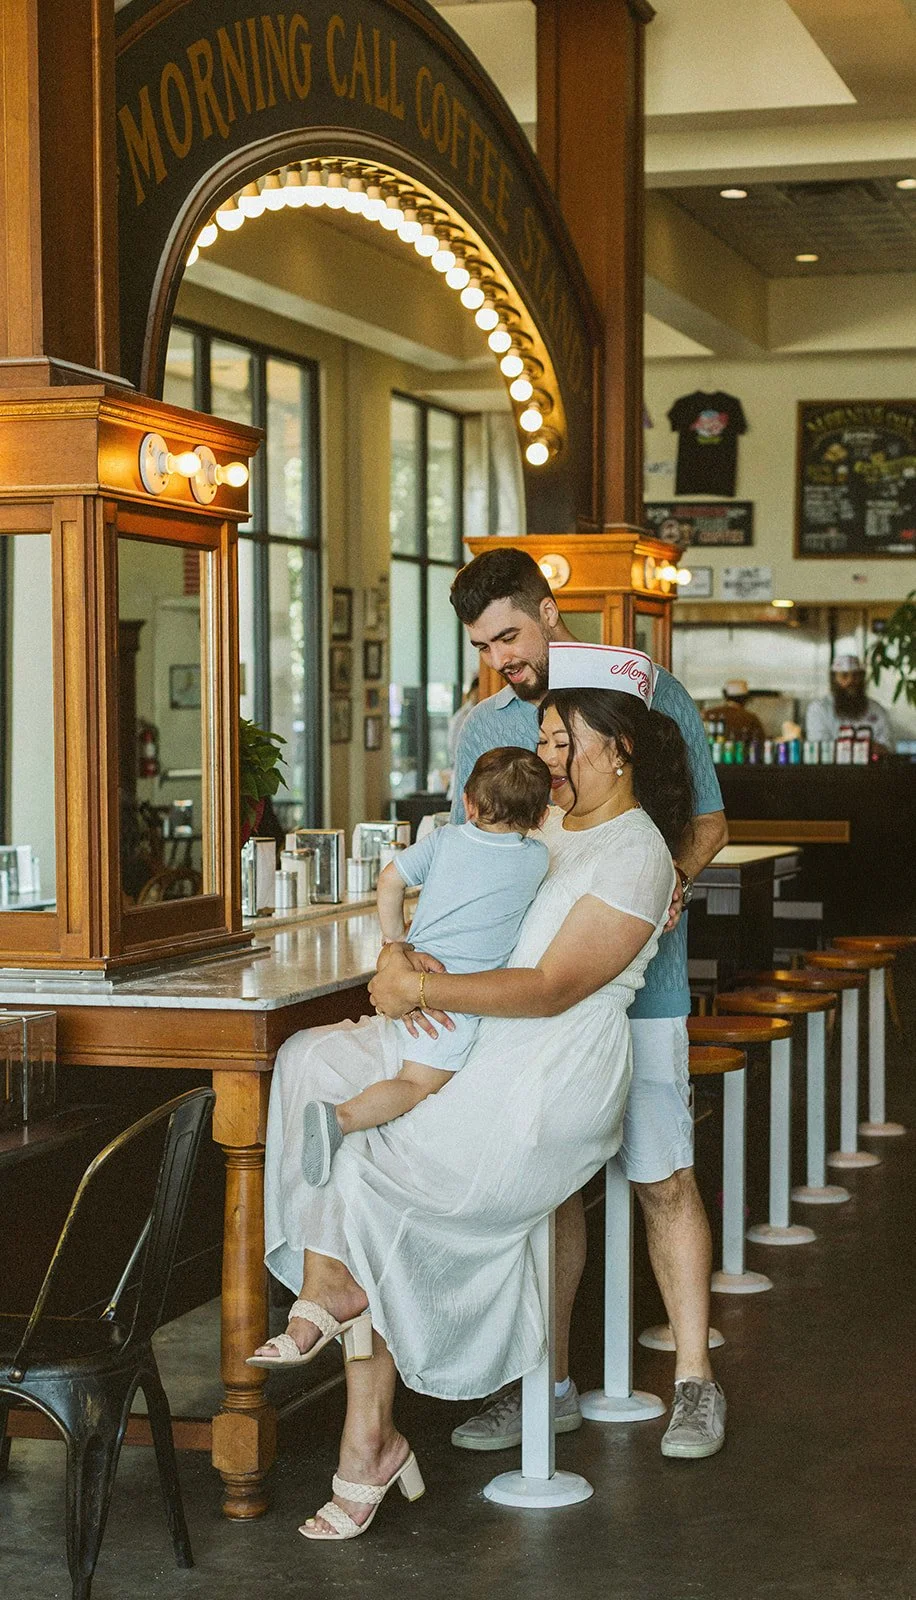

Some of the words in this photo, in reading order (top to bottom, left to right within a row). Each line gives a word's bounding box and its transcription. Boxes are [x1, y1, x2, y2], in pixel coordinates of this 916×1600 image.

[117, 14, 312, 206] MORNING
[326, 14, 405, 121] CALL
[414, 66, 514, 235] COFFEE
[611, 660, 650, 689] Morn
